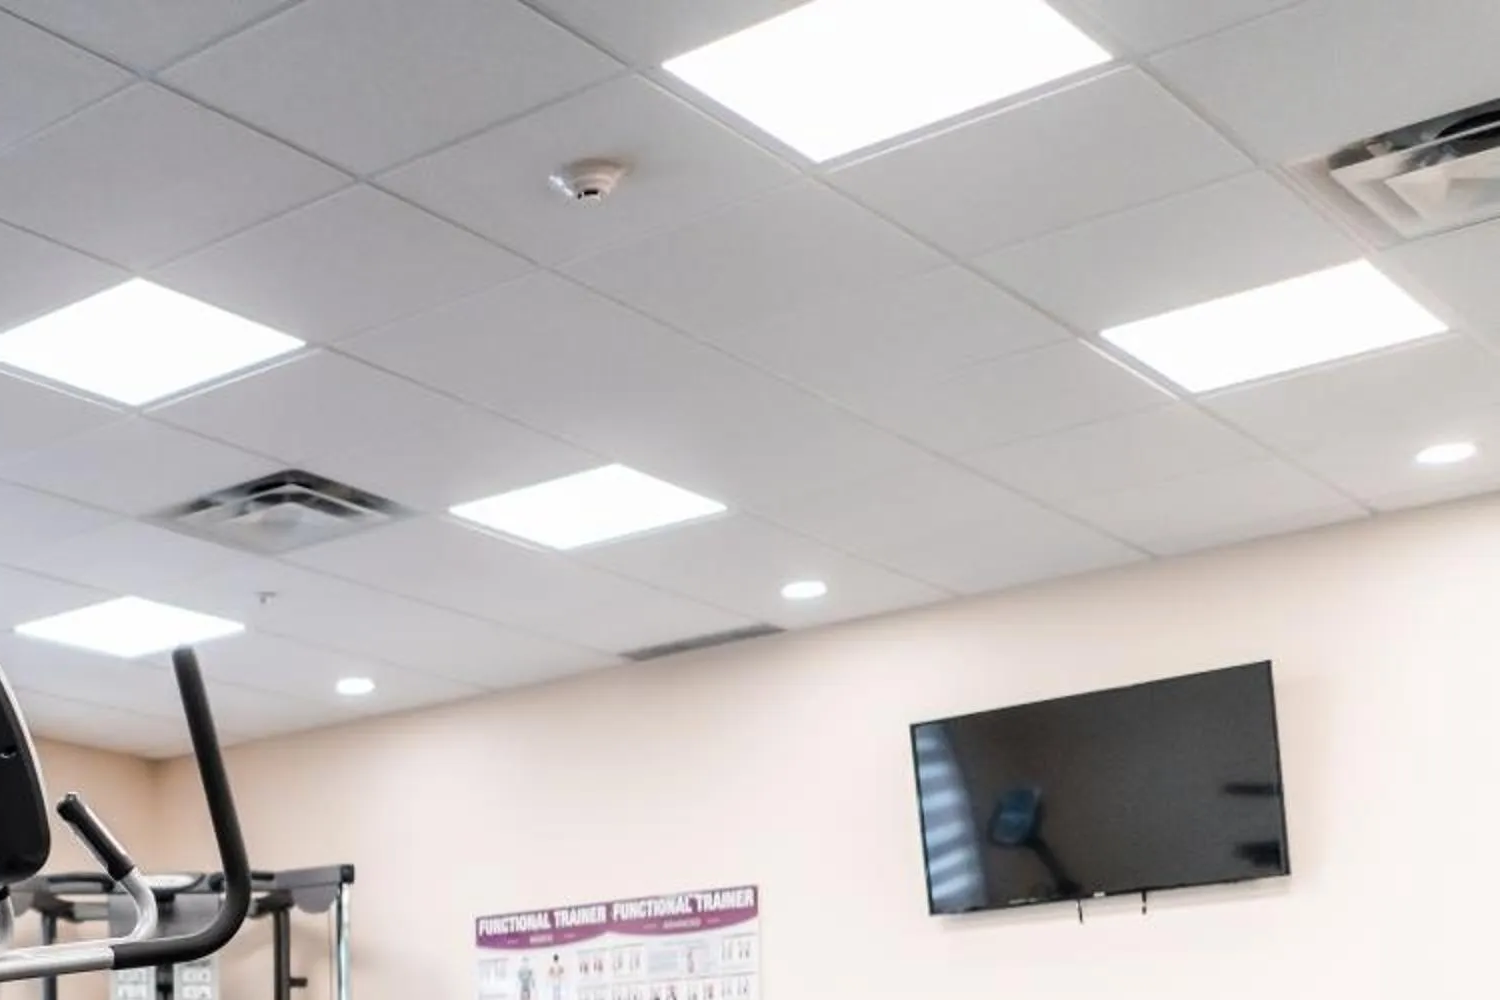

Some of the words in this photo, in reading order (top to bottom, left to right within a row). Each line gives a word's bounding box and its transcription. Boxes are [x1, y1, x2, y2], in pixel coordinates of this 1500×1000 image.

[479, 911, 552, 937] FUNCTIONAL
[554, 905, 607, 929] TRAINER
[612, 895, 694, 922] FUNCTIONAL
[696, 888, 755, 913] TRAINER
